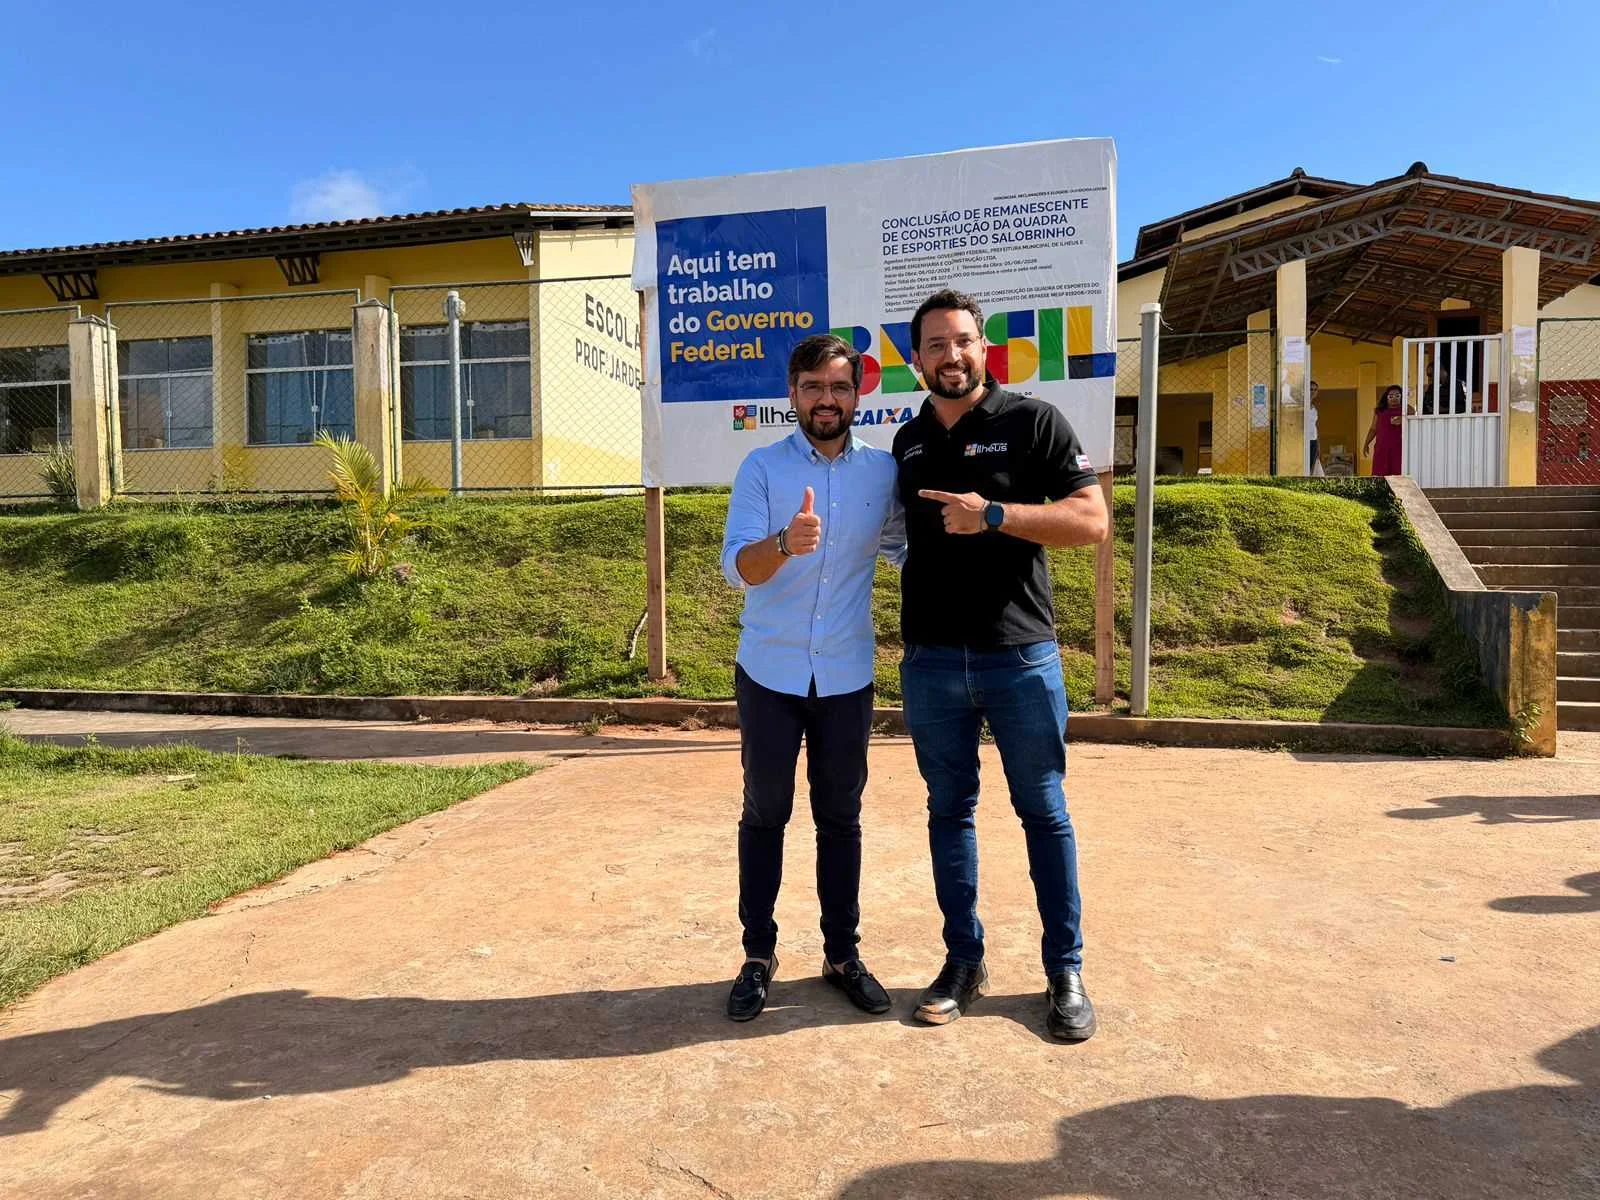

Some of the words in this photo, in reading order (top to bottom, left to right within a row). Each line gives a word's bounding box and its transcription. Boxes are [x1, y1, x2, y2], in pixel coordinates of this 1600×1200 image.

[964, 208, 980, 220] DE
[984, 198, 1089, 218] REMANESCENTE
[882, 232, 898, 243] DE
[994, 219, 1010, 230] DA
[1013, 214, 1068, 228] QUADRA
[883, 244, 899, 256] DE
[970, 234, 989, 246] DO
[992, 226, 1076, 244] SALOBRINHO
[667, 251, 721, 280] Aqui
[727, 250, 776, 272] tem
[668, 278, 774, 305] trabalho
[585, 292, 640, 350] ESCOLA
[668, 312, 701, 334] do
[706, 310, 814, 332] Governo
[670, 337, 765, 363] Federal
[760, 405, 797, 424] Ilhé
